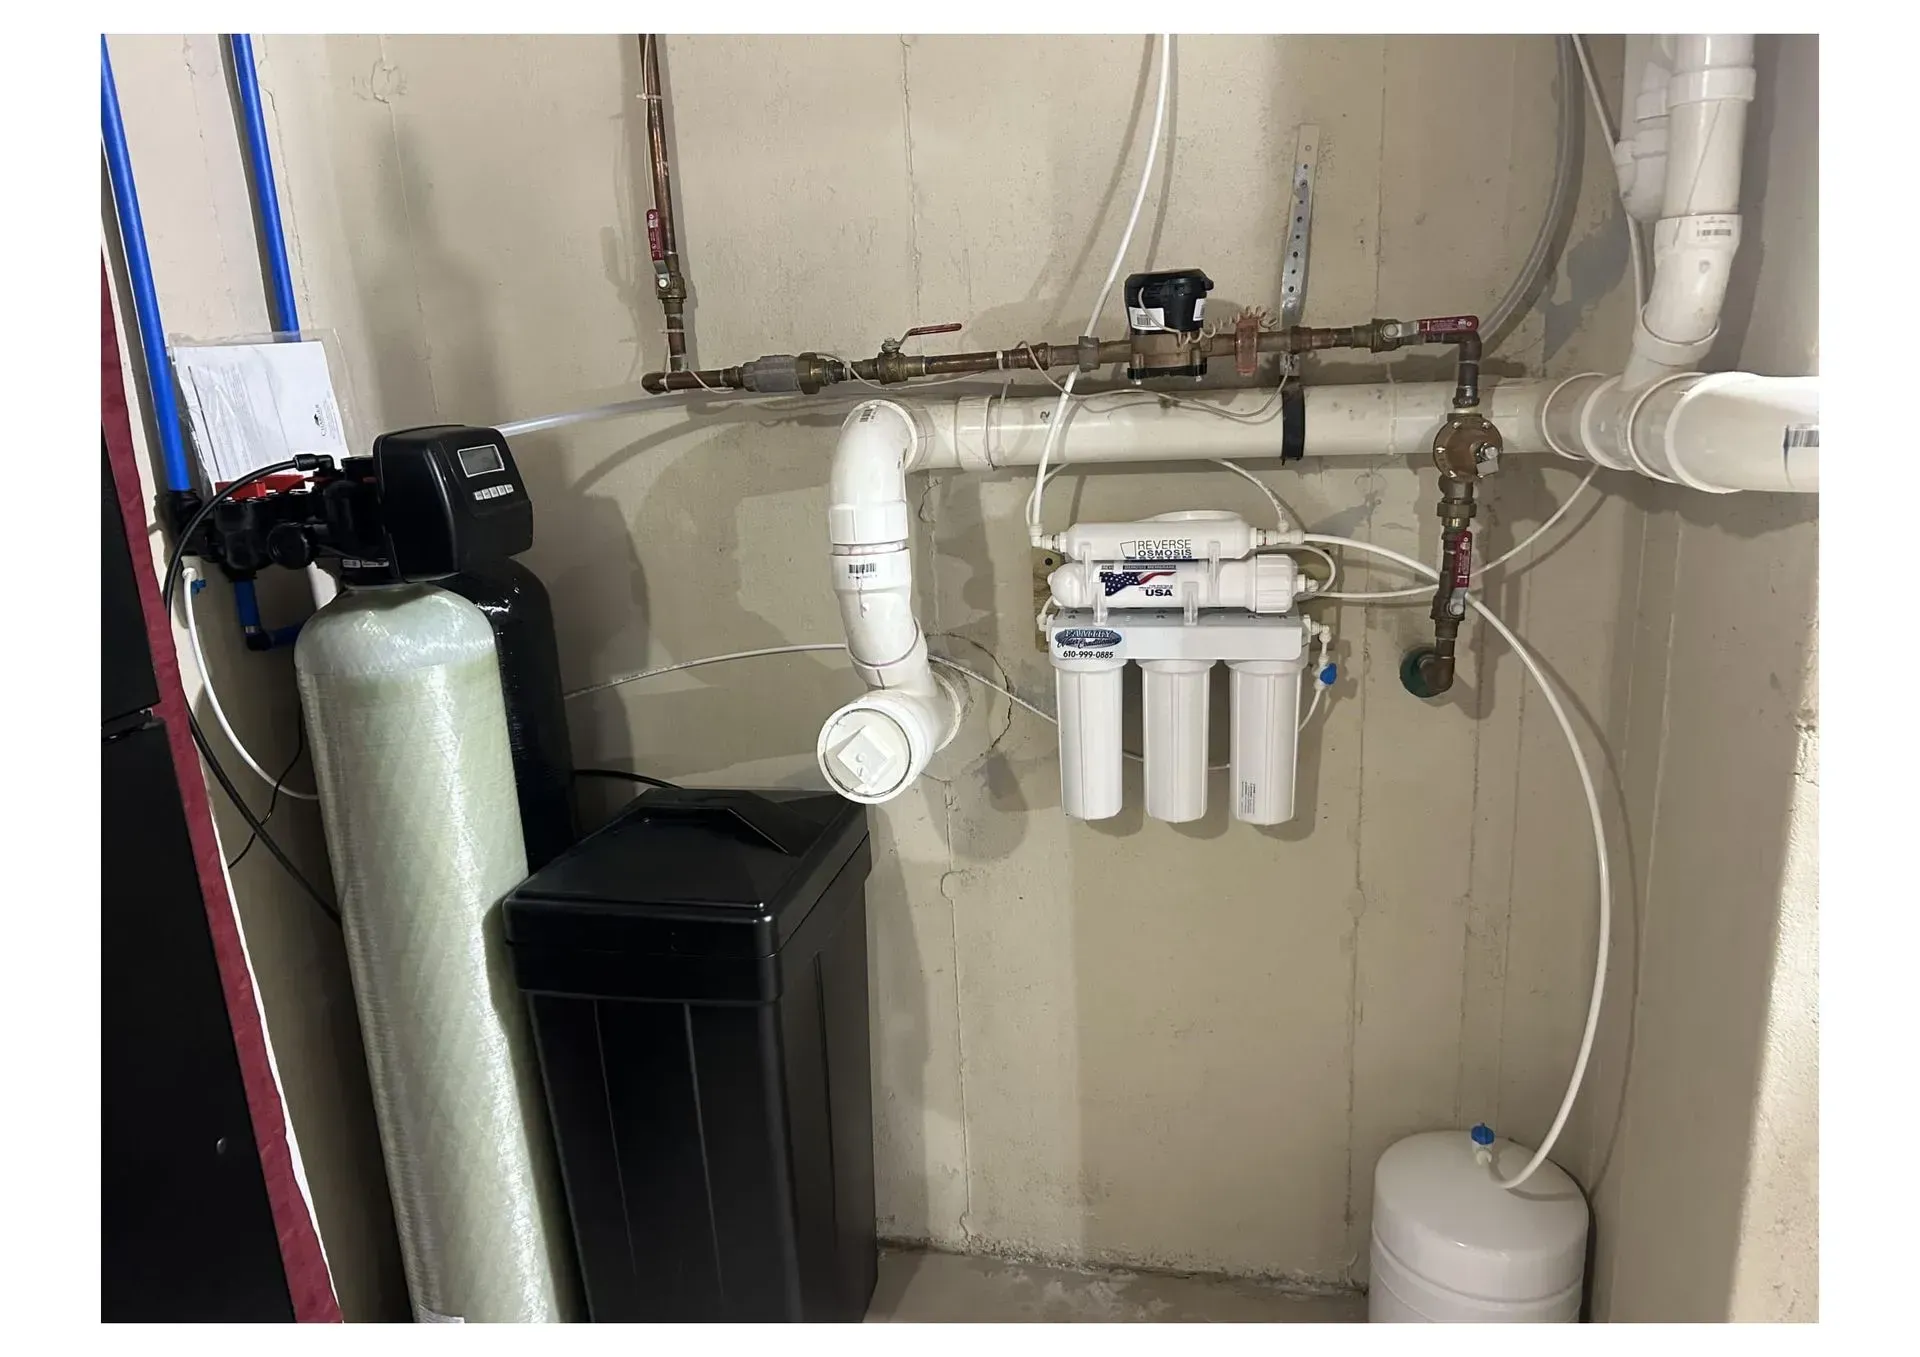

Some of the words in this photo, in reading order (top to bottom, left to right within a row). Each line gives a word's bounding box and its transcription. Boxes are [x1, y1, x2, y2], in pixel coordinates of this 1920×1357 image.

[1138, 539, 1192, 550] REVERSE
[1138, 549, 1192, 557] OSMOSIS
[1145, 589, 1173, 597] USA
[1063, 650, 1114, 659] 610-999-0885
